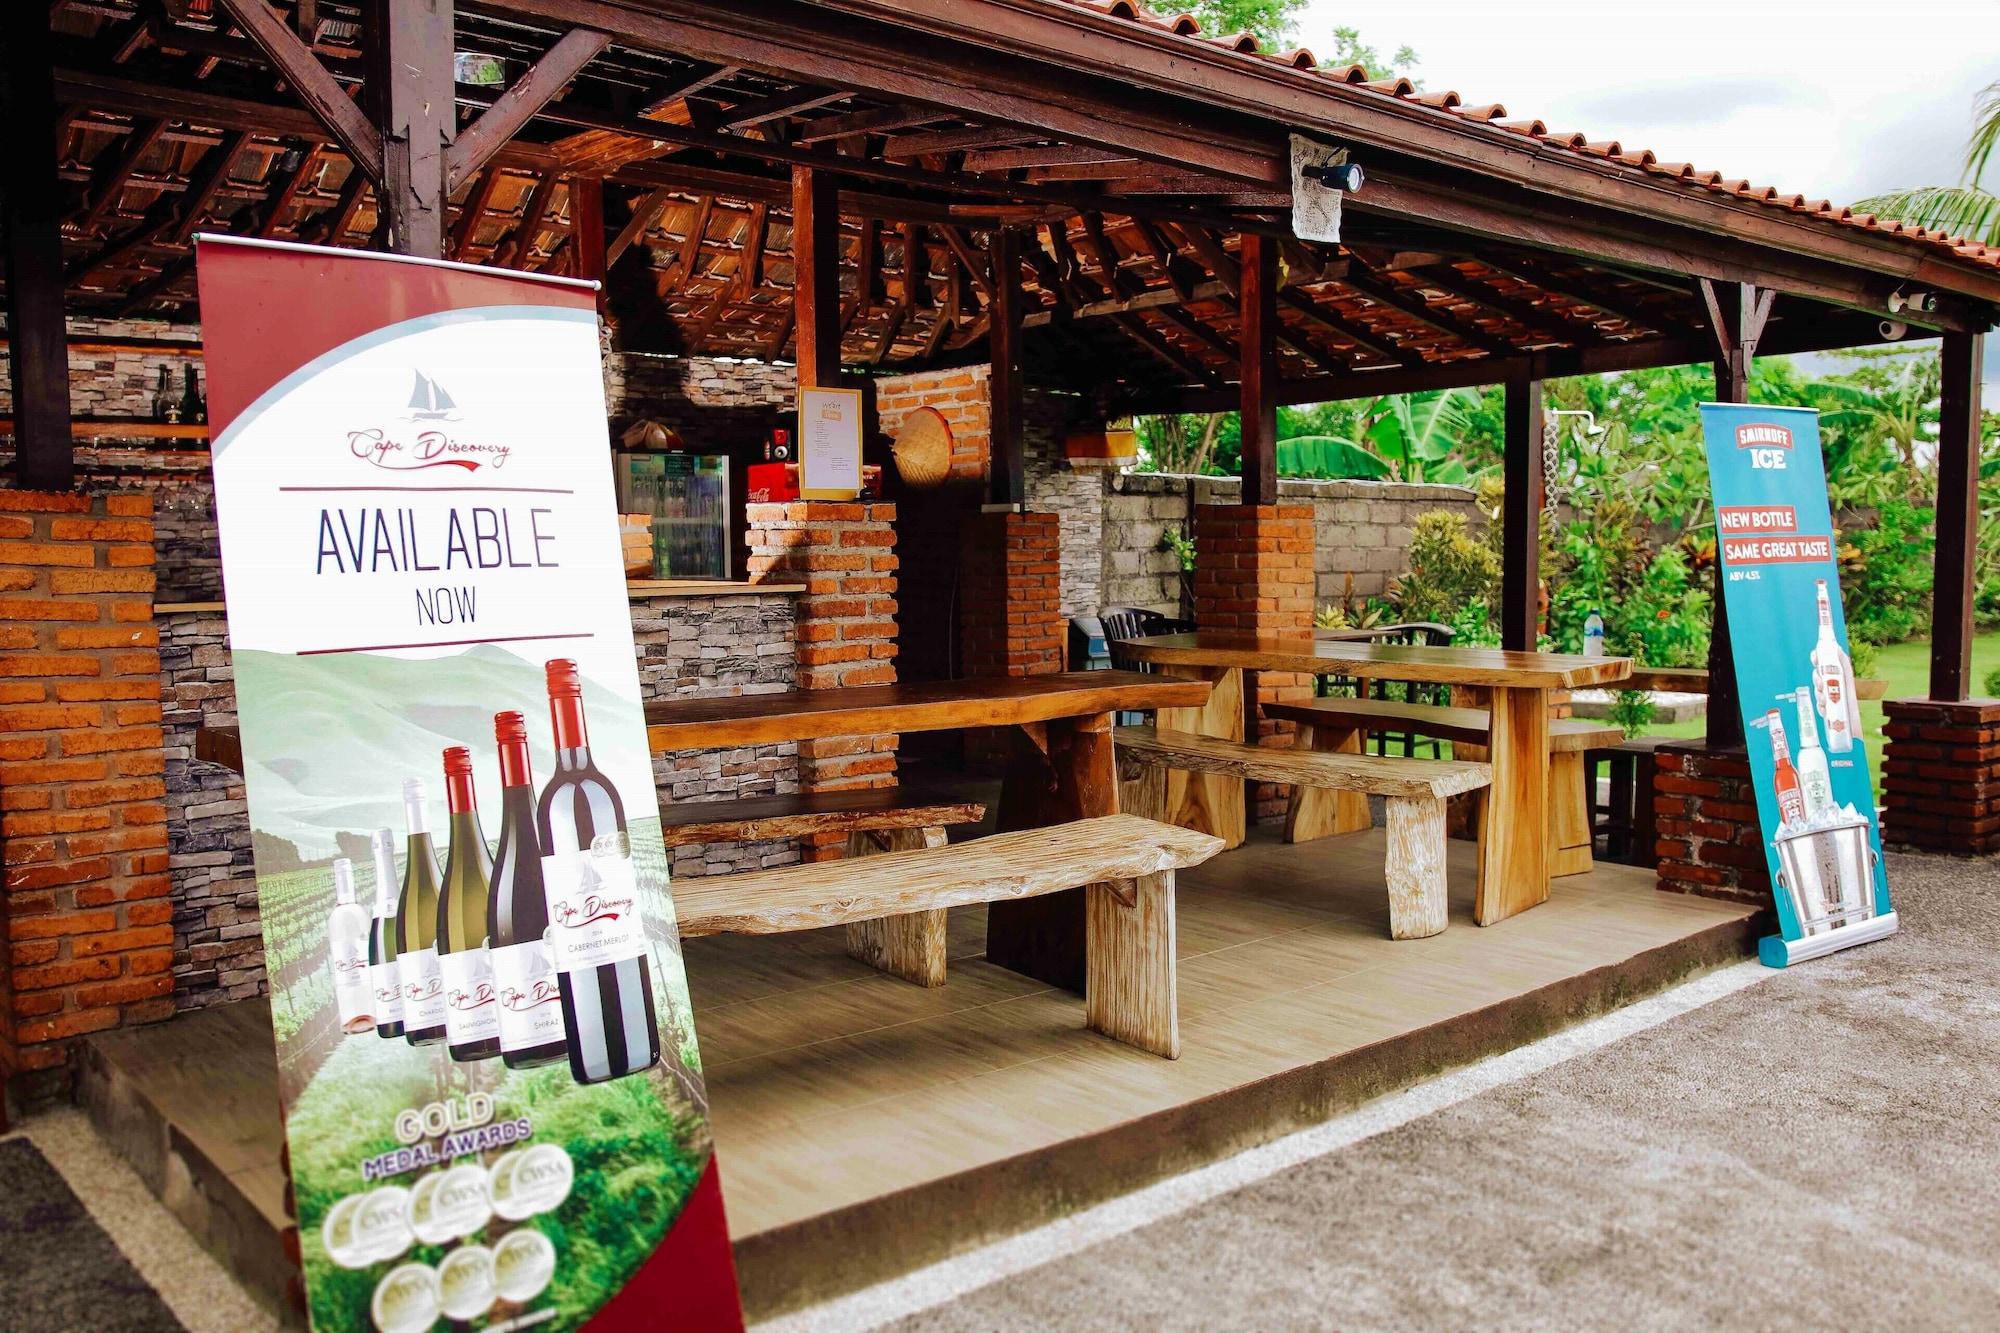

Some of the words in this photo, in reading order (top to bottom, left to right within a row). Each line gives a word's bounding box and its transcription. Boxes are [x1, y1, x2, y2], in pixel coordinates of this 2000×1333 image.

[1739, 427, 1788, 445] SMIRNOFF
[347, 428, 403, 464] Cape
[412, 431, 511, 469] Discovery
[1750, 448, 1787, 469] ICE
[1721, 512, 1749, 528] NEW
[1752, 511, 1793, 527] BOTTLE
[316, 507, 559, 575] AVAILABLE
[1725, 543, 1760, 560] SAME
[1762, 542, 1797, 558] GREAT
[1798, 541, 1829, 556] TASTE
[1729, 571, 1744, 581] ABV
[416, 586, 476, 626] NOW
[553, 901, 578, 925] Cape
[583, 895, 634, 917] Discovery
[567, 940, 604, 953] CABERNET
[500, 987, 527, 1009] Cape
[396, 1092, 494, 1144] GOLD
[363, 1146, 439, 1181] MEDAL
[441, 1117, 532, 1157] AWARDS
